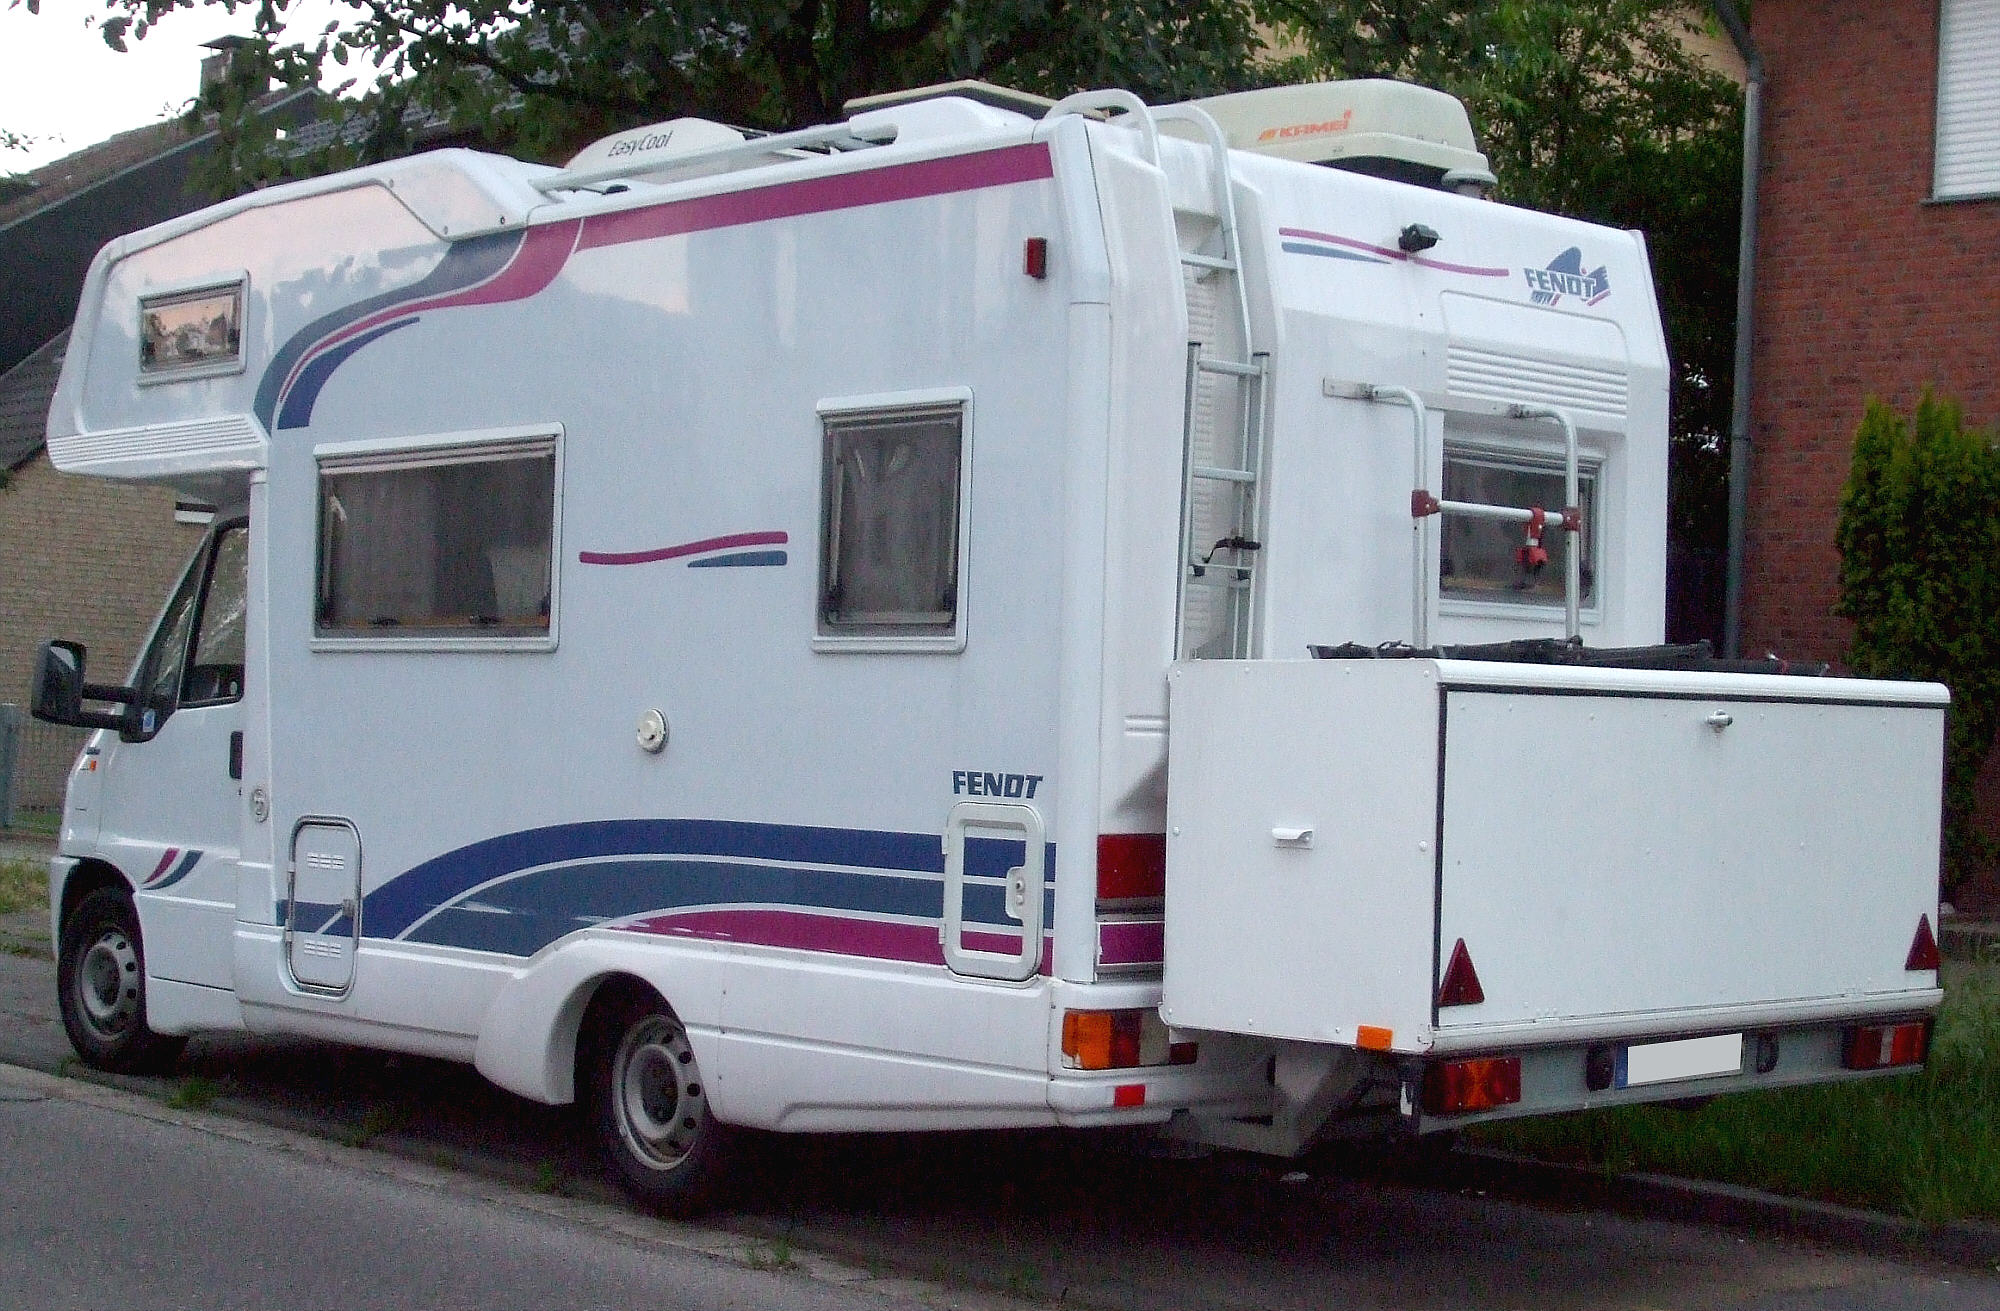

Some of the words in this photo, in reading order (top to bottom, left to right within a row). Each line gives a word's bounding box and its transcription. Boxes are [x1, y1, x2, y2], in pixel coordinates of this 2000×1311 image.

[608, 130, 674, 157] EasyCool
[1523, 267, 1596, 299] FENDT
[952, 770, 1044, 799] FENDT
